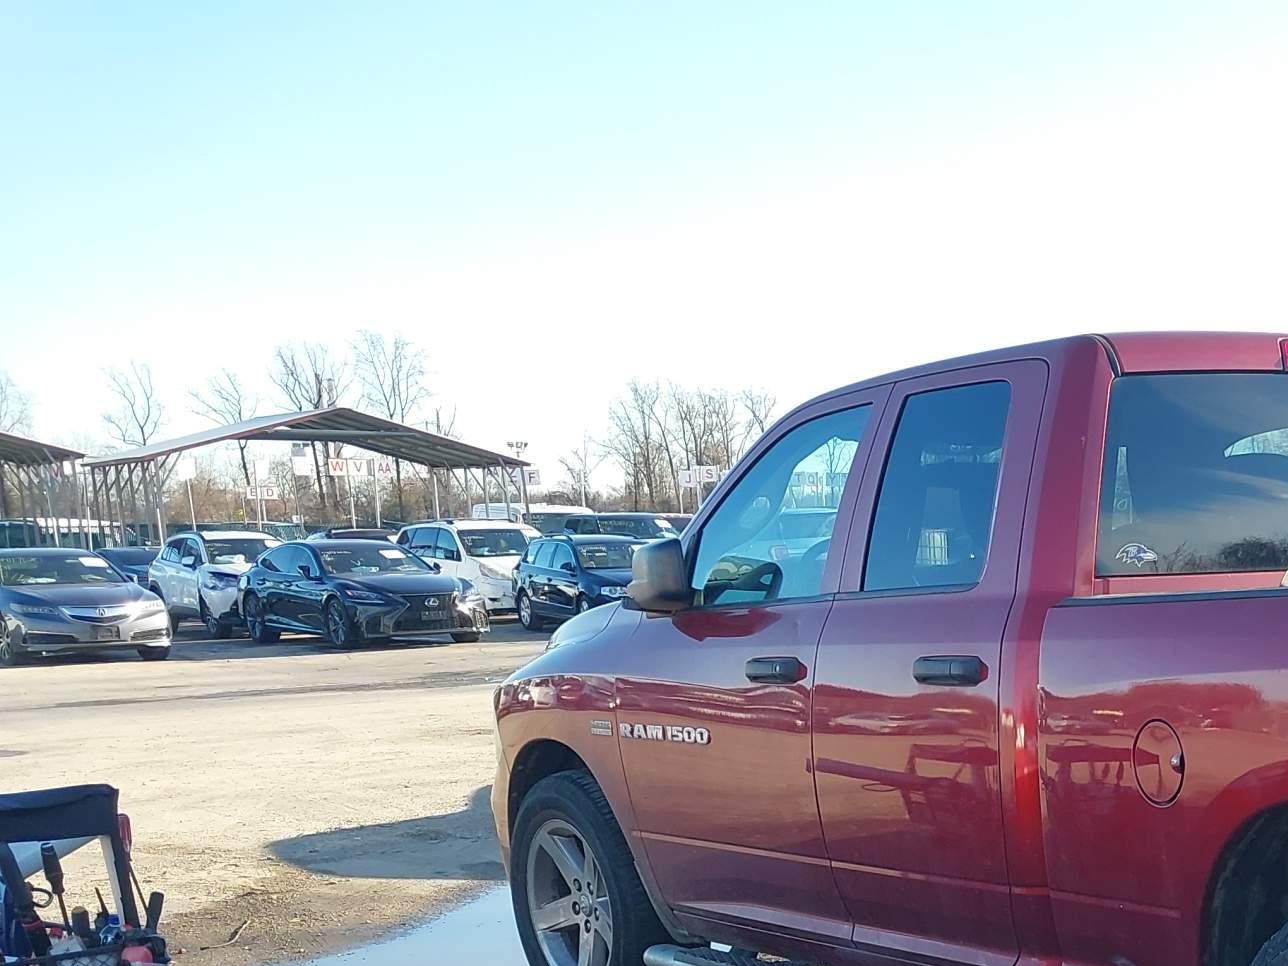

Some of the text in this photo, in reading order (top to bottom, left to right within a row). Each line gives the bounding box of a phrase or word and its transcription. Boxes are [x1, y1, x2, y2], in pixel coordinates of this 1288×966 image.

[330, 461, 344, 472] W
[378, 462, 391, 474] AA
[705, 468, 714, 479] S
[619, 722, 664, 741] RAM
[665, 725, 711, 745] 1500
